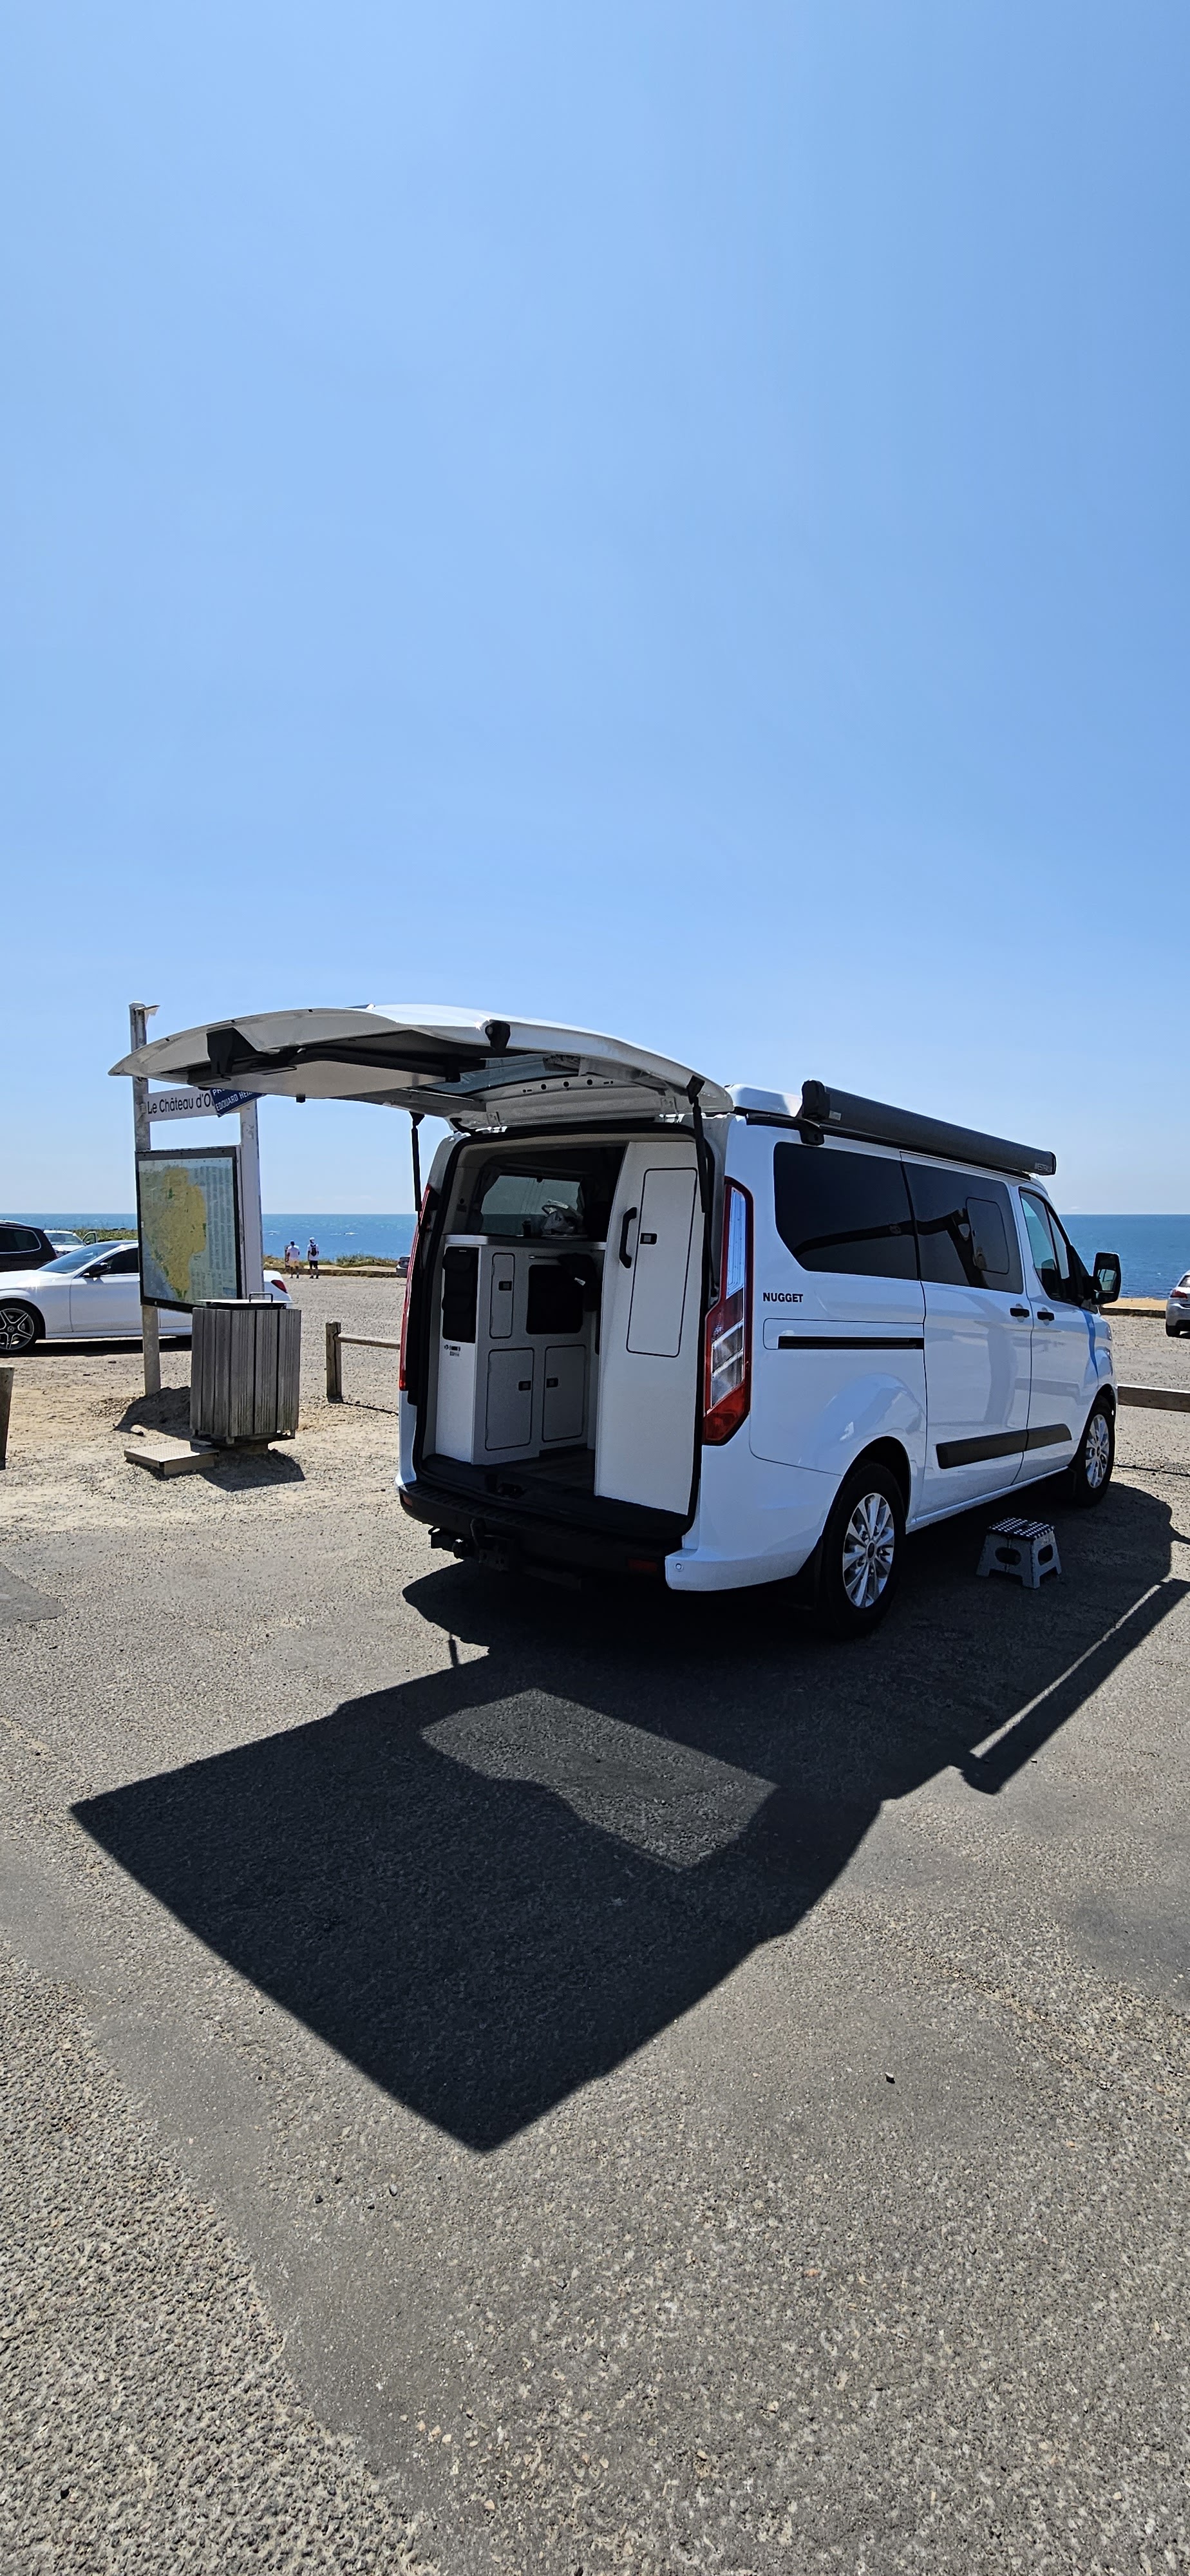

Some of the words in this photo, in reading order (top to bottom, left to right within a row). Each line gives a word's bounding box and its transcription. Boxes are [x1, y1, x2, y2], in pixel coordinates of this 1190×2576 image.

[147, 1101, 157, 1114] Le
[159, 1097, 194, 1113] Château
[762, 1292, 804, 1303] NUGGET
